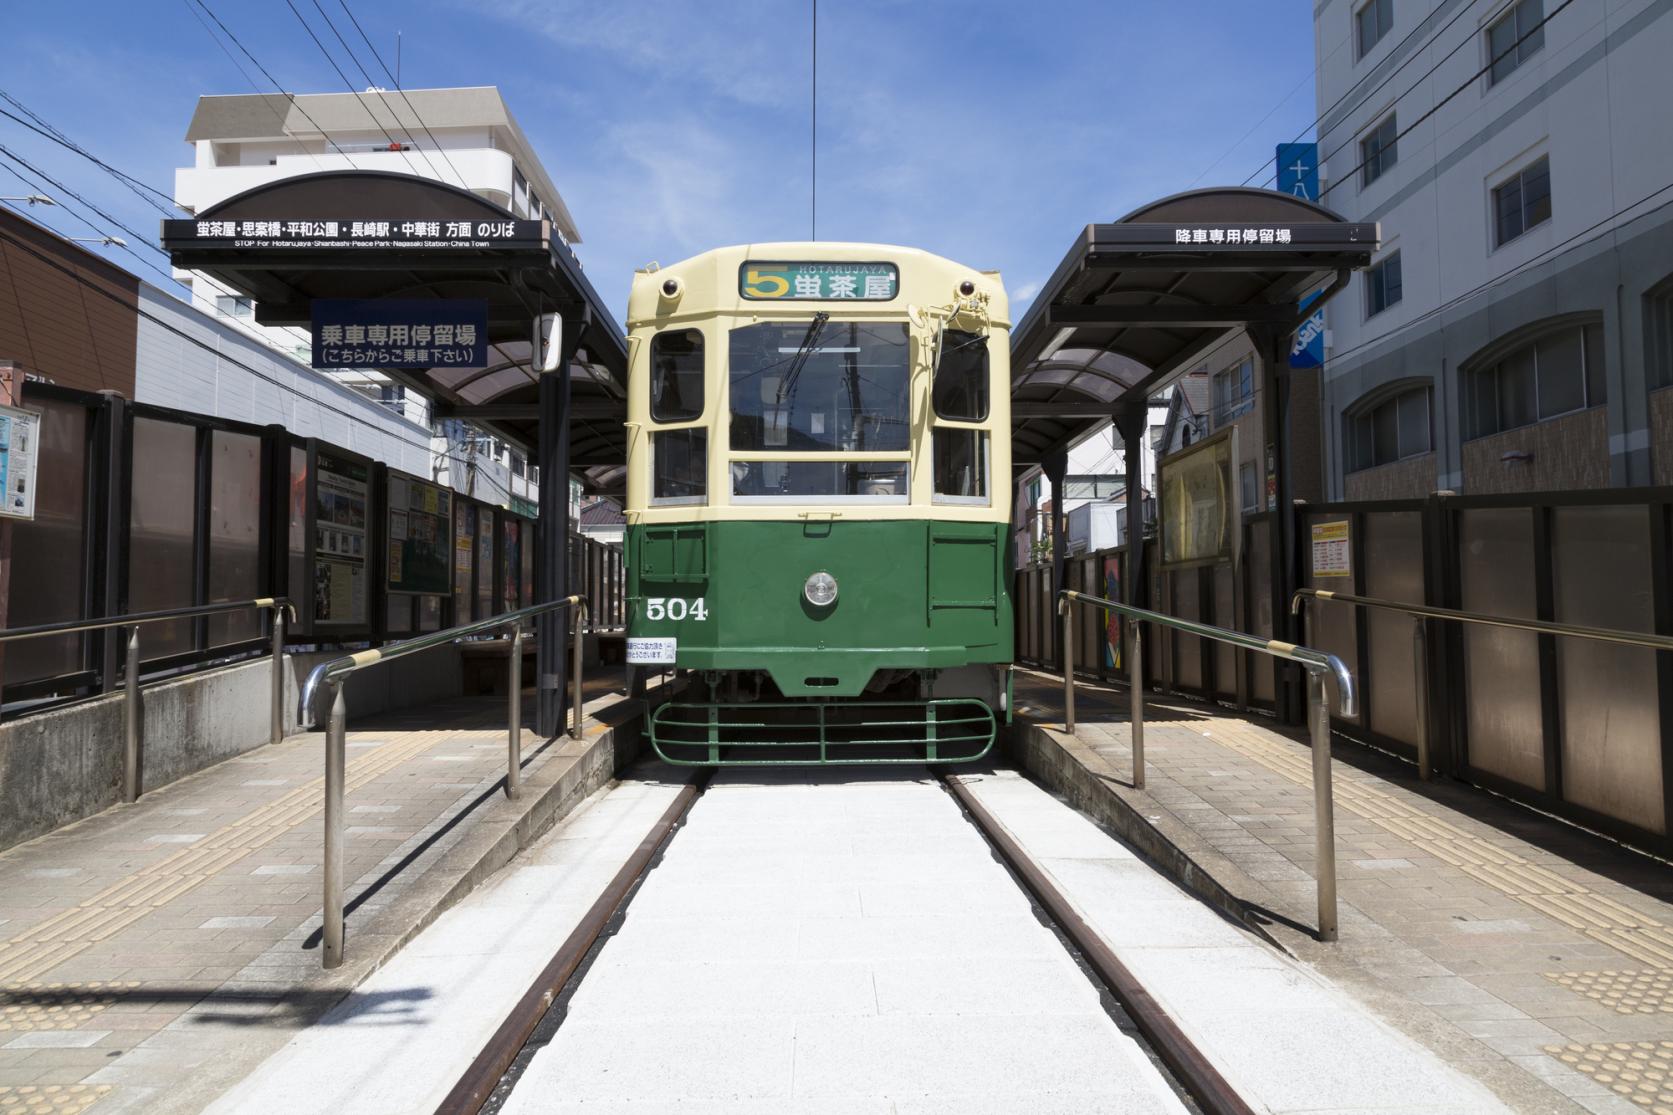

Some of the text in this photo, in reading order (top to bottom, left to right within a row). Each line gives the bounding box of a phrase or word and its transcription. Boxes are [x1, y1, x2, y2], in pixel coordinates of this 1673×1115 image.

[445, 222, 472, 238] 方面
[477, 222, 515, 238] のりば
[1175, 229, 1292, 244] 降車専用停留場
[471, 240, 490, 248] Town
[799, 265, 887, 274] HOTARUJAYA
[744, 265, 790, 298] 5
[794, 274, 891, 298] 蛍茶屋
[321, 324, 477, 347] 乗車専用停留場
[646, 597, 709, 621] 504
